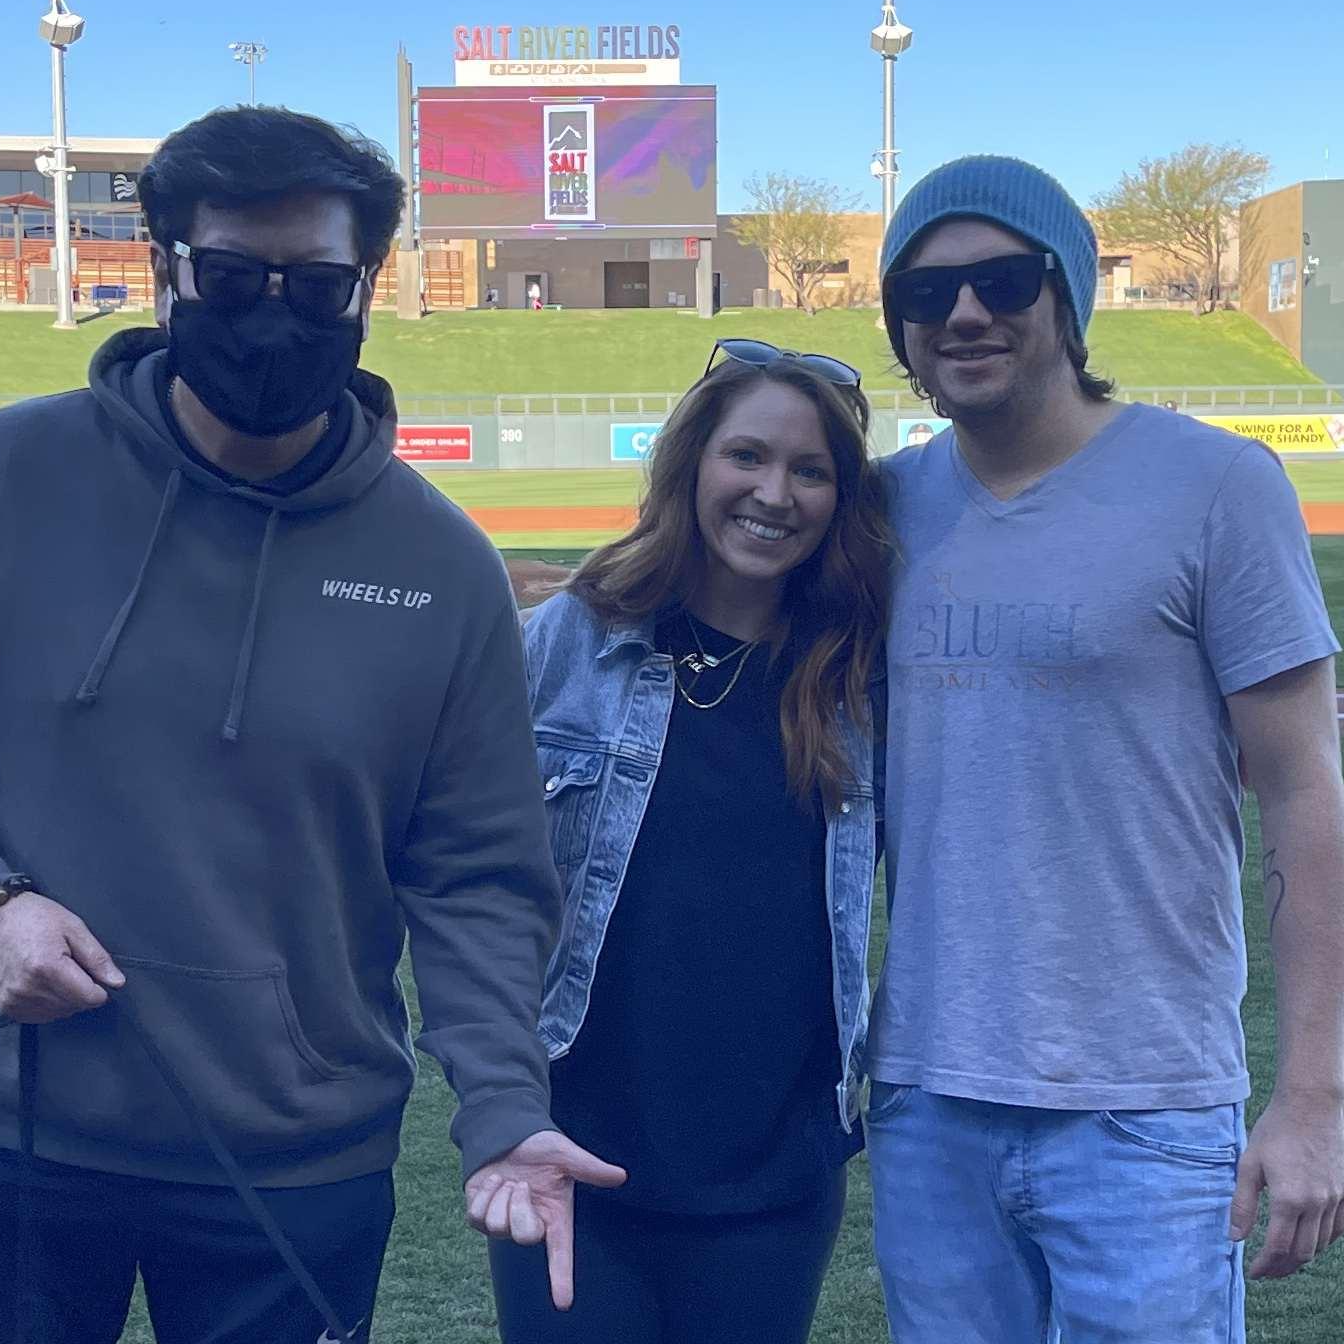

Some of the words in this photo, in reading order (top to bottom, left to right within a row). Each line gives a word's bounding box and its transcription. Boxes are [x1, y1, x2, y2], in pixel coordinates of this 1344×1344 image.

[453, 25, 512, 61] SALT
[518, 26, 589, 60] RIVER
[597, 25, 680, 60] FIELDS
[549, 152, 587, 173] SALT
[501, 429, 523, 442] 390
[1234, 424, 1275, 433] SWING
[1280, 424, 1302, 433] FOR
[1306, 424, 1314, 433] A
[1277, 434, 1325, 443] SHANDY
[322, 579, 401, 606] WHEELS
[403, 590, 432, 609] UP
